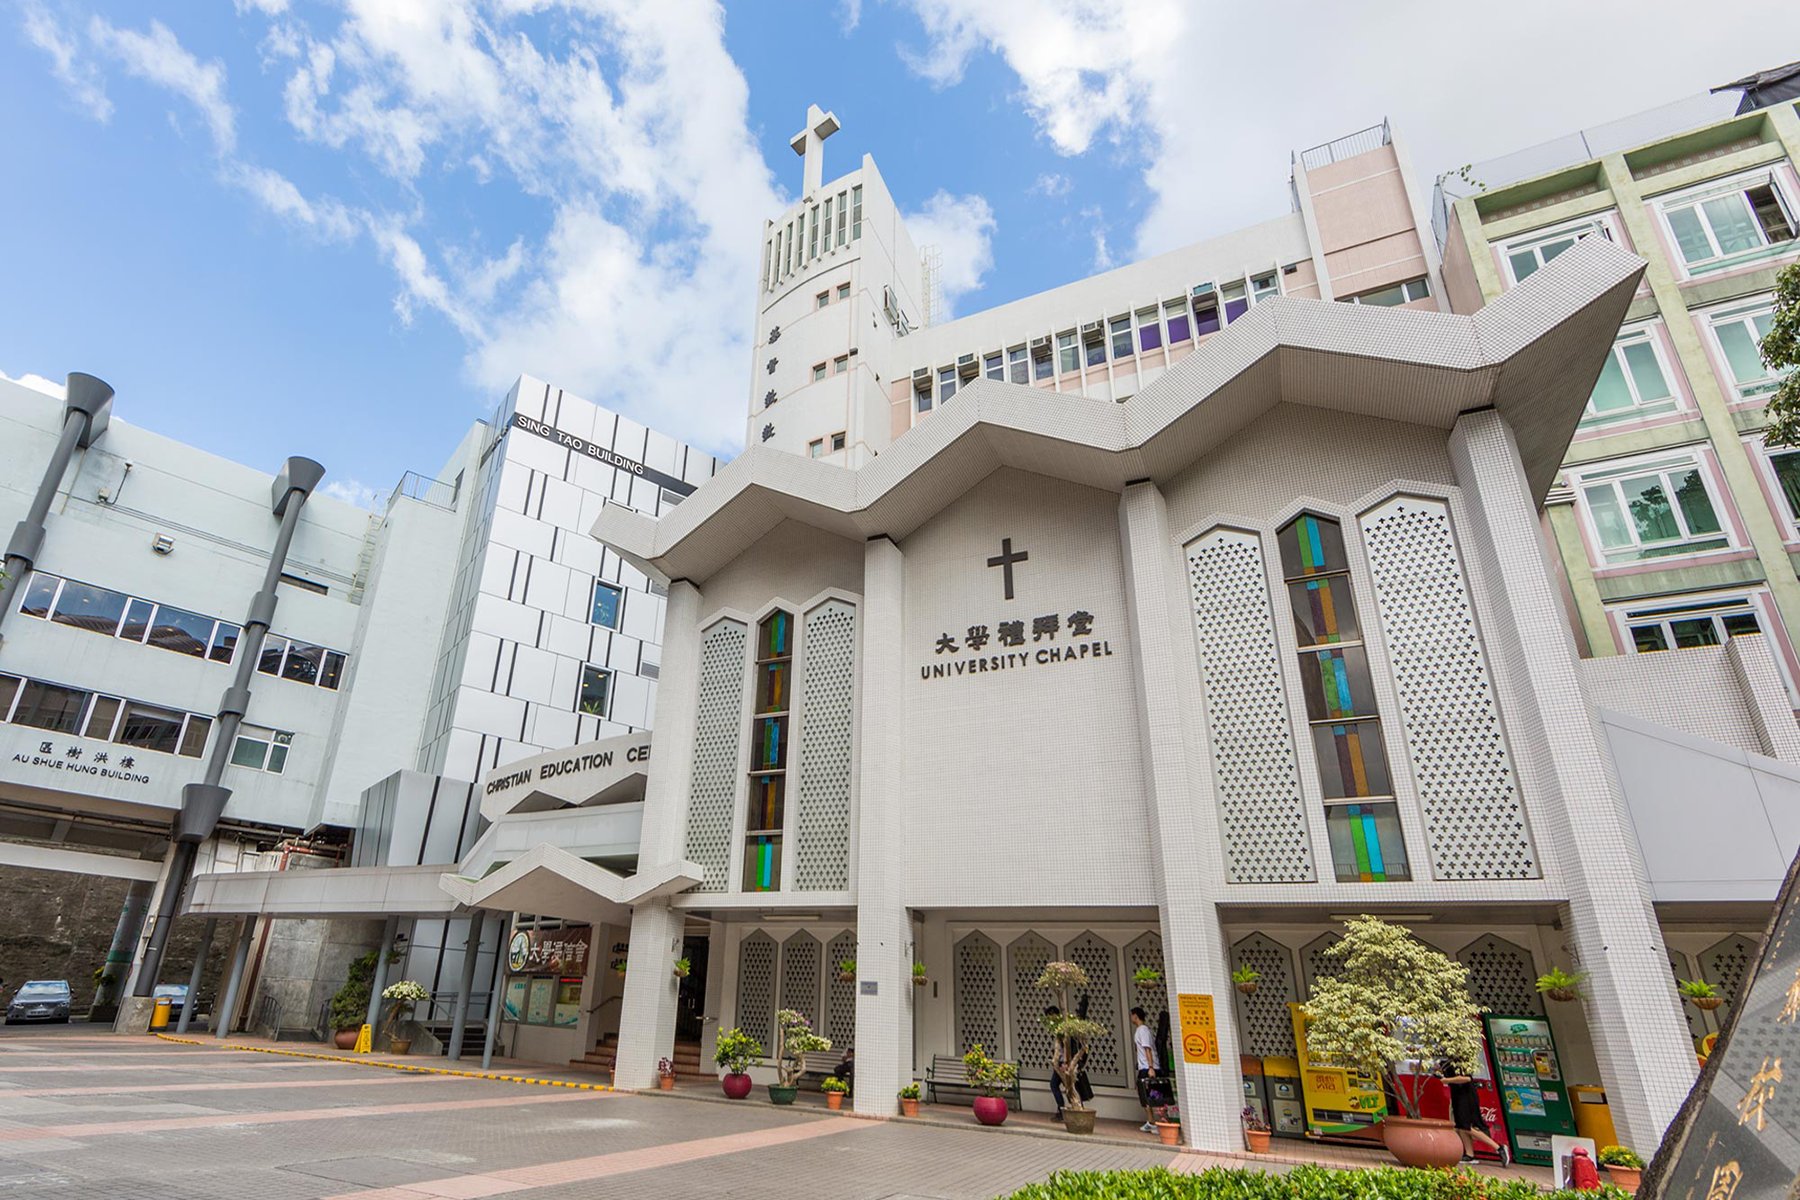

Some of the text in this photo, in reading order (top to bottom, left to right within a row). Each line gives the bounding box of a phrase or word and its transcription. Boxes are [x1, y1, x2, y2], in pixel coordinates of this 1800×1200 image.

[517, 415, 644, 475] SING TAO BUILDING
[935, 610, 1095, 655] 大學禮拜堂
[921, 640, 1113, 680] UNIVERSITY CHAPEL
[12, 753, 150, 784] AU SHUE HUNG BUILDING
[39, 741, 136, 769] 區樹洪樓
[486, 768, 533, 795] CHRISTIAN
[539, 750, 614, 780] EDUCATION
